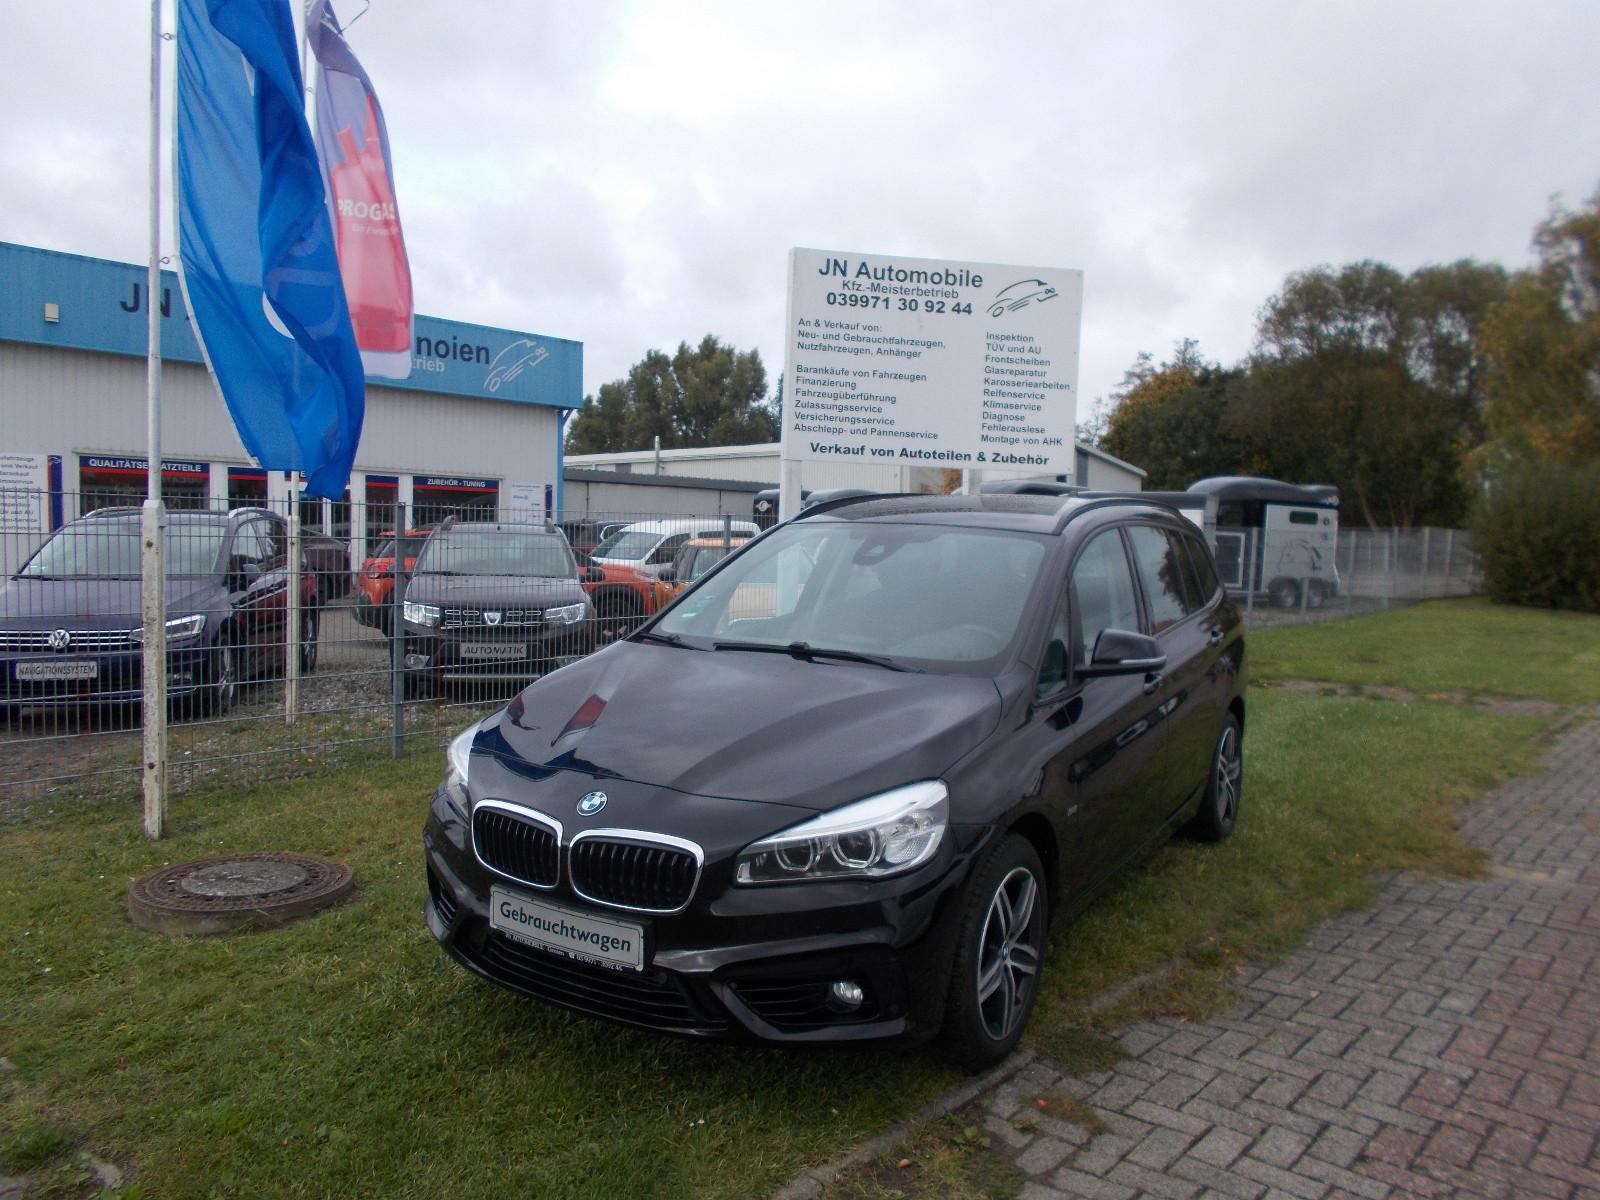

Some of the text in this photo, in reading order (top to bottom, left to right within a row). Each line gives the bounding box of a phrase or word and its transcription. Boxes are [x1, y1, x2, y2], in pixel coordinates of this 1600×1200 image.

[819, 258, 983, 288] JN Automobile
[842, 280, 959, 299] Kfz.-Meisterbetrieb
[827, 292, 973, 315] 039971 30 92 44
[798, 318, 883, 333] An & Verkauf von:
[798, 330, 946, 349] Neu- und Gebrauchtfahrzeugen,
[986, 332, 1034, 343] Inspektion
[798, 342, 921, 359] Nutzfahrzeugen, Anhänger
[986, 342, 1042, 355] TÜV und AU
[985, 355, 1050, 367] Frontscheiben
[796, 365, 927, 382] Barankäufe von Fahrzeugen
[985, 366, 1047, 379] Glasreparatur
[796, 377, 857, 389] Finanzierung
[984, 378, 1070, 391] Karosseriearbeiten
[795, 388, 897, 404] Fahrzeugüberführung
[983, 389, 1046, 400] Reifenservice
[795, 401, 883, 414] Zulassungsservice
[983, 401, 1042, 412] Klimaservice
[795, 412, 895, 426] Versicherungsservice
[982, 412, 1025, 423] Diagnose
[794, 424, 938, 440] Abschlepp- und Pannenservice
[982, 423, 1045, 434] Fehlerauslese
[981, 434, 1063, 446] Montage von AHK
[811, 442, 1050, 465] Verkauf von Autoteilen & Zubehör
[464, 646, 523, 654] AUTOMATIK
[500, 901, 631, 952] Gebrauchtwagen
